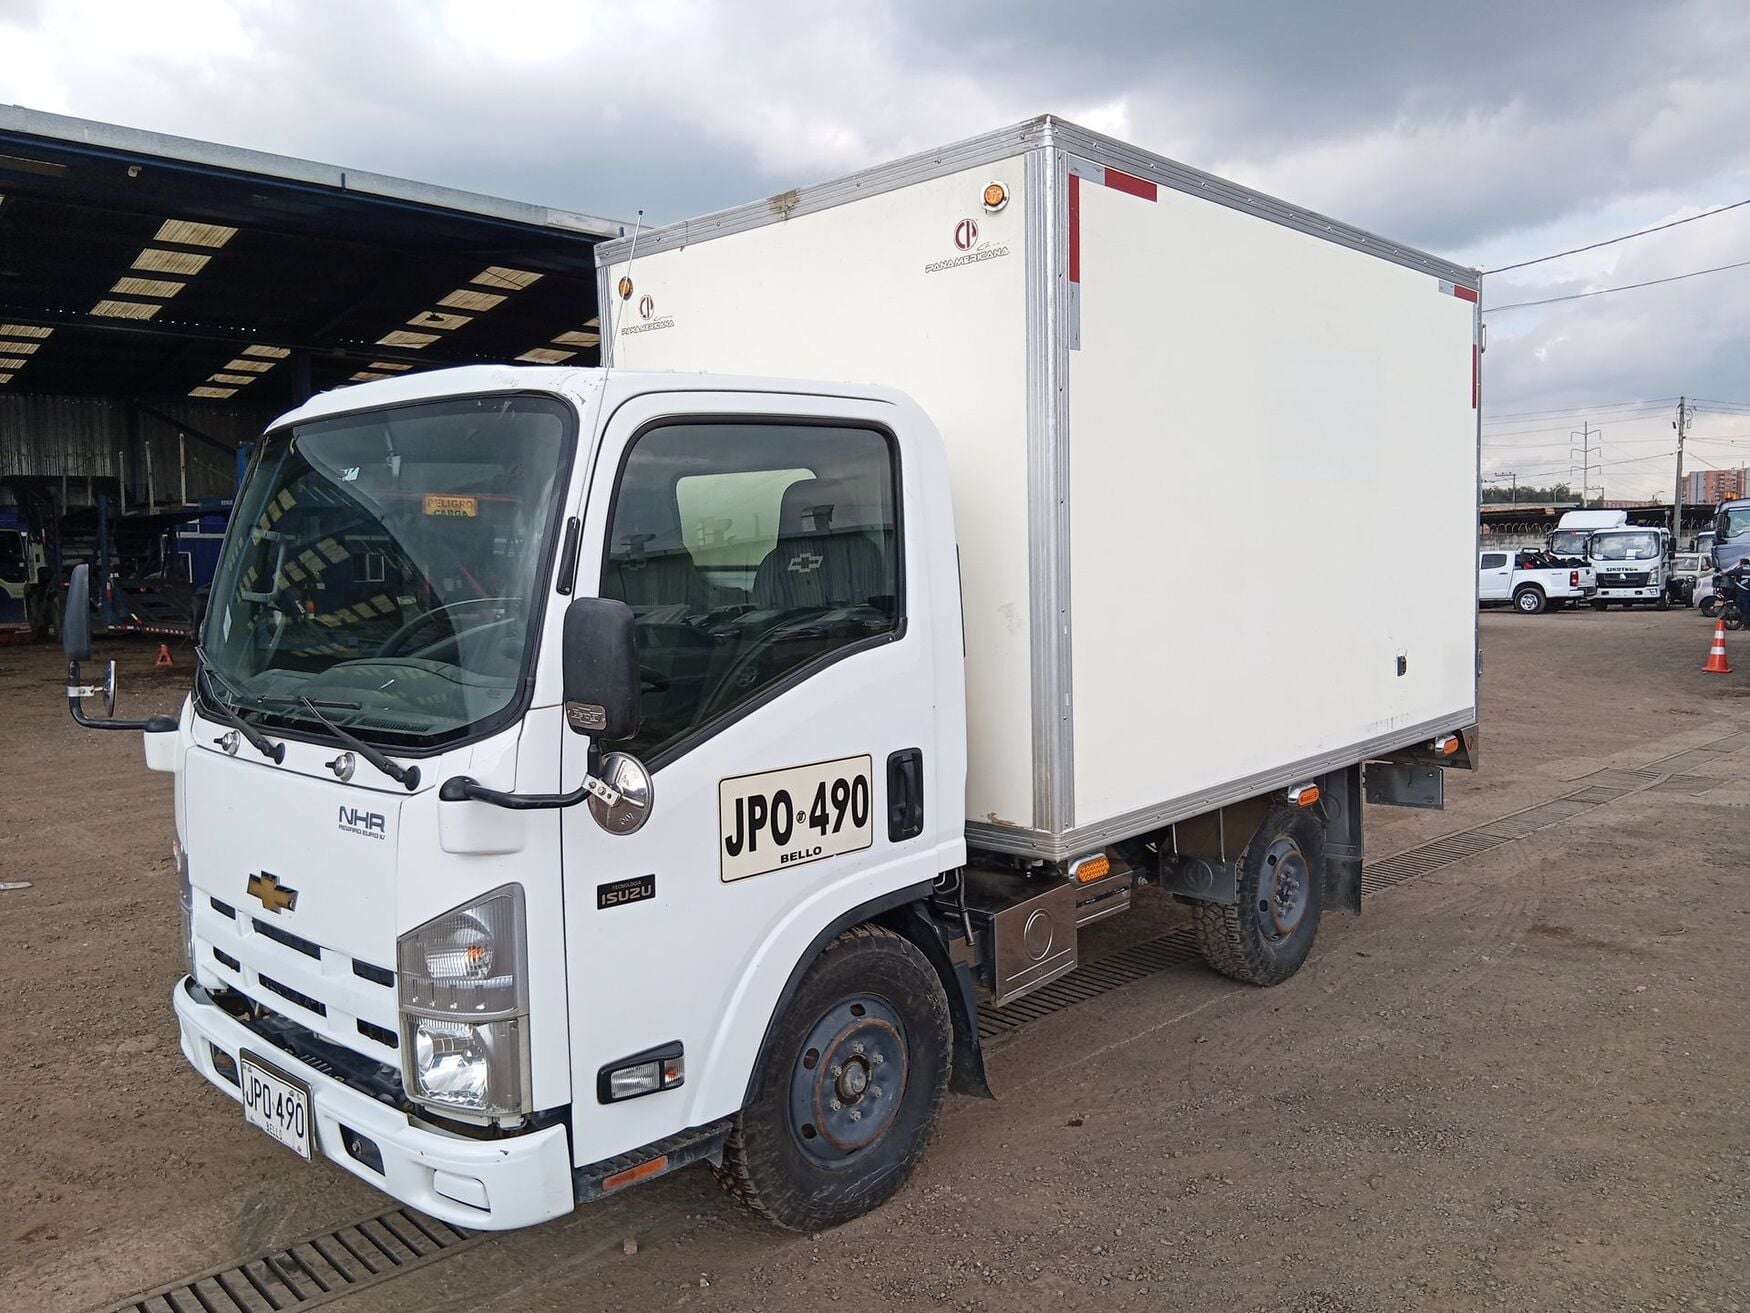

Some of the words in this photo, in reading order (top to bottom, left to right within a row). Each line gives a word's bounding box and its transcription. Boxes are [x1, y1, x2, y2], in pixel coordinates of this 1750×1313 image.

[925, 246, 1010, 273] PANAMERICANA
[427, 498, 473, 509] PELIGRO
[809, 774, 869, 836] 490
[339, 805, 386, 833] NHR
[780, 846, 822, 864] BELLO
[601, 884, 652, 905] ISUZU
[276, 1092, 305, 1139] 490
